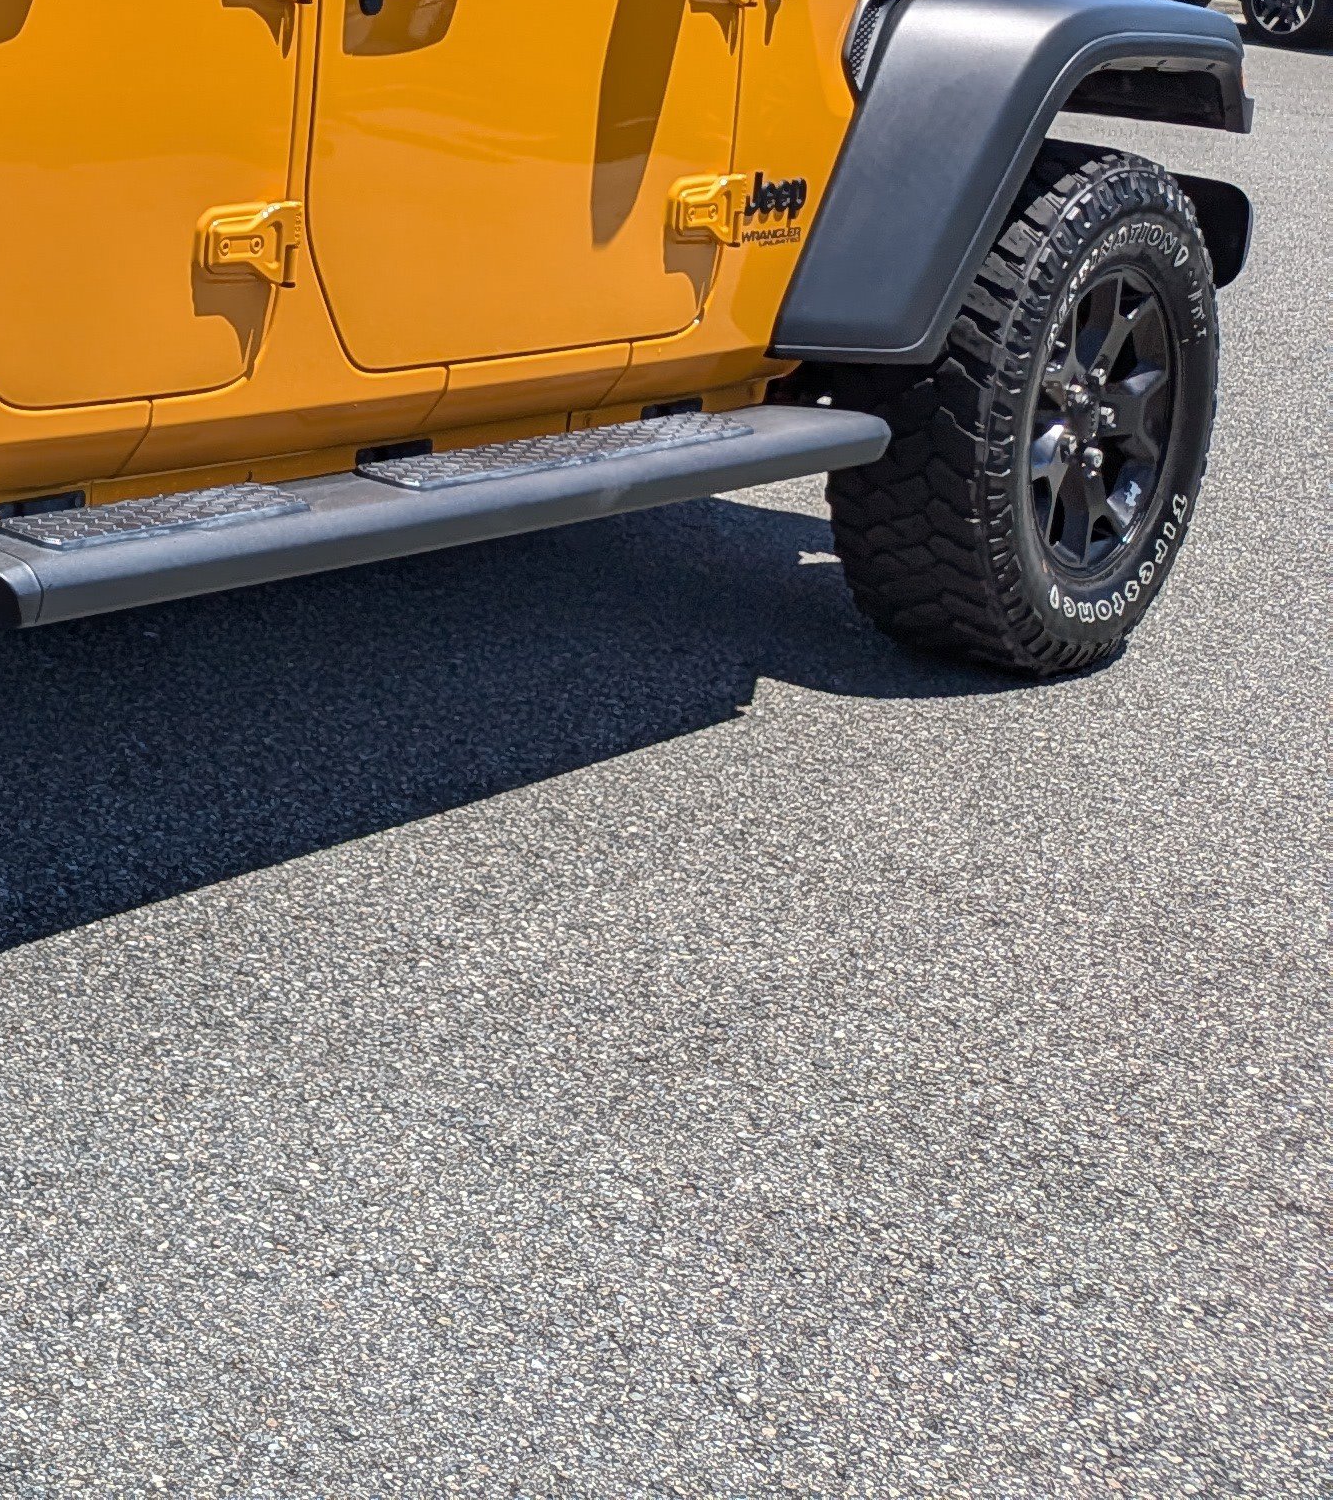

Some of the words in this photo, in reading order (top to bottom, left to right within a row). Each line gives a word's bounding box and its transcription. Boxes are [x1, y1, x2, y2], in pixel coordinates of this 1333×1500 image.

[741, 227, 801, 243] WRANGLER
[743, 171, 807, 220] Jeep
[1047, 222, 1178, 352] INATION
[1063, 494, 1187, 623] Firestone
